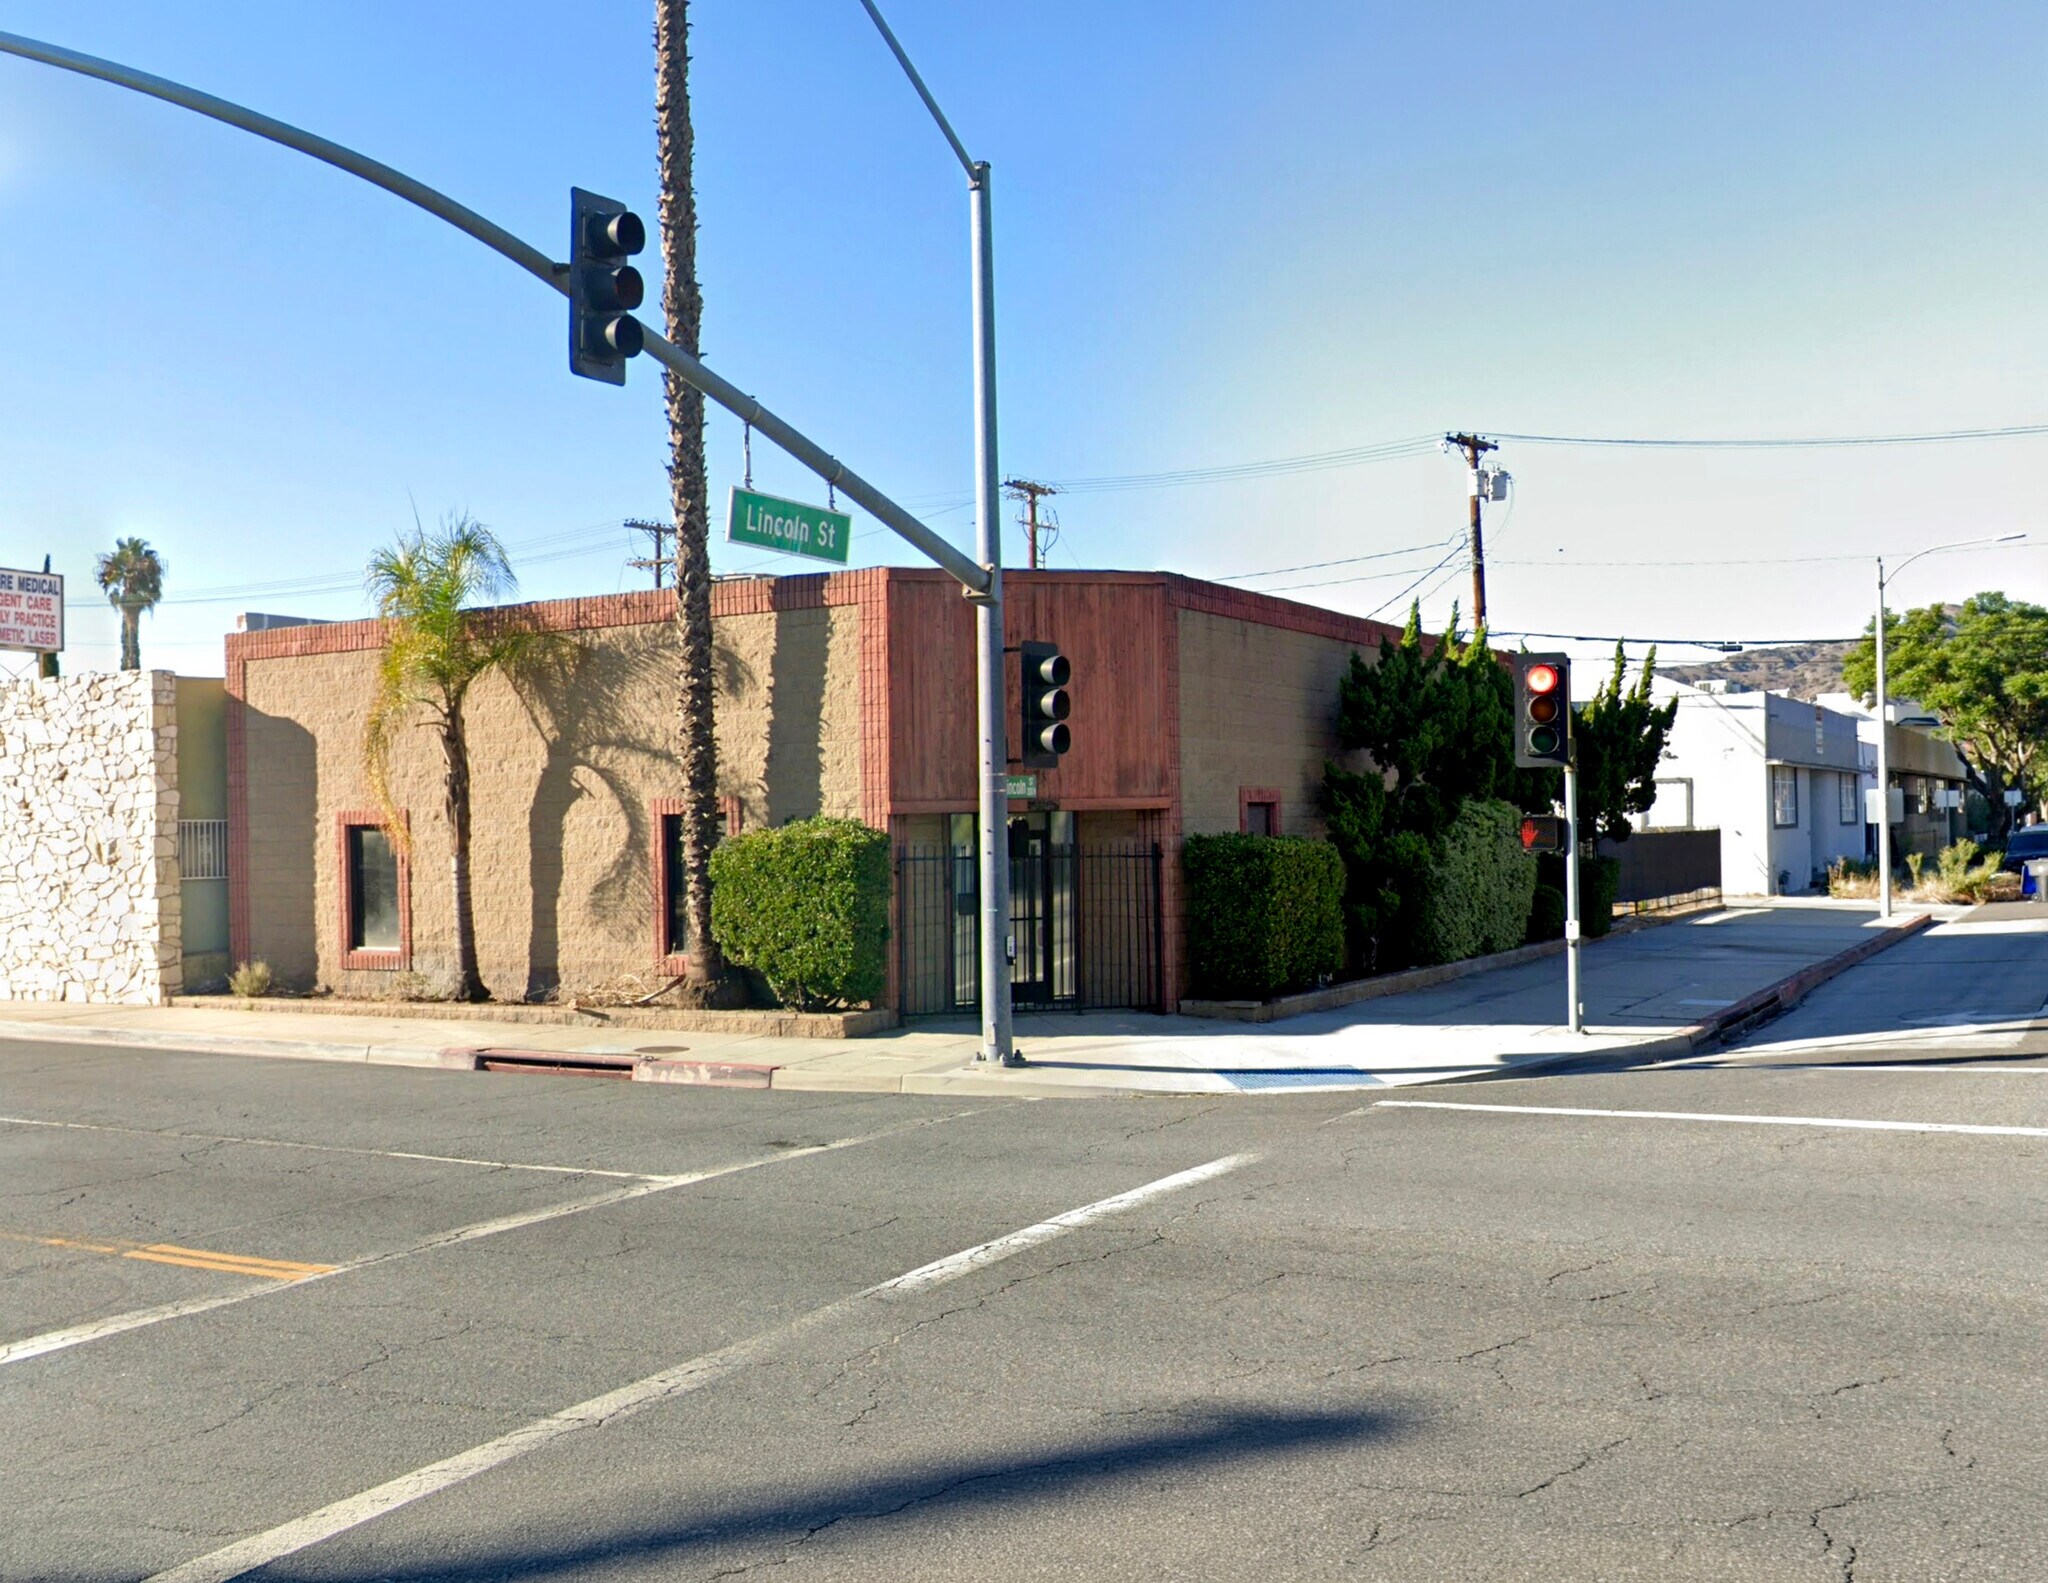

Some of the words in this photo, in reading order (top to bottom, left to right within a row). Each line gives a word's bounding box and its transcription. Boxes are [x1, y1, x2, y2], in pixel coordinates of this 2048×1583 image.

[746, 504, 809, 543] Lincoln
[818, 521, 836, 548] St
[18, 576, 59, 595] MEDICAL
[27, 596, 52, 611] CARE
[14, 611, 56, 628] PRACTICE
[29, 630, 57, 645] LASER
